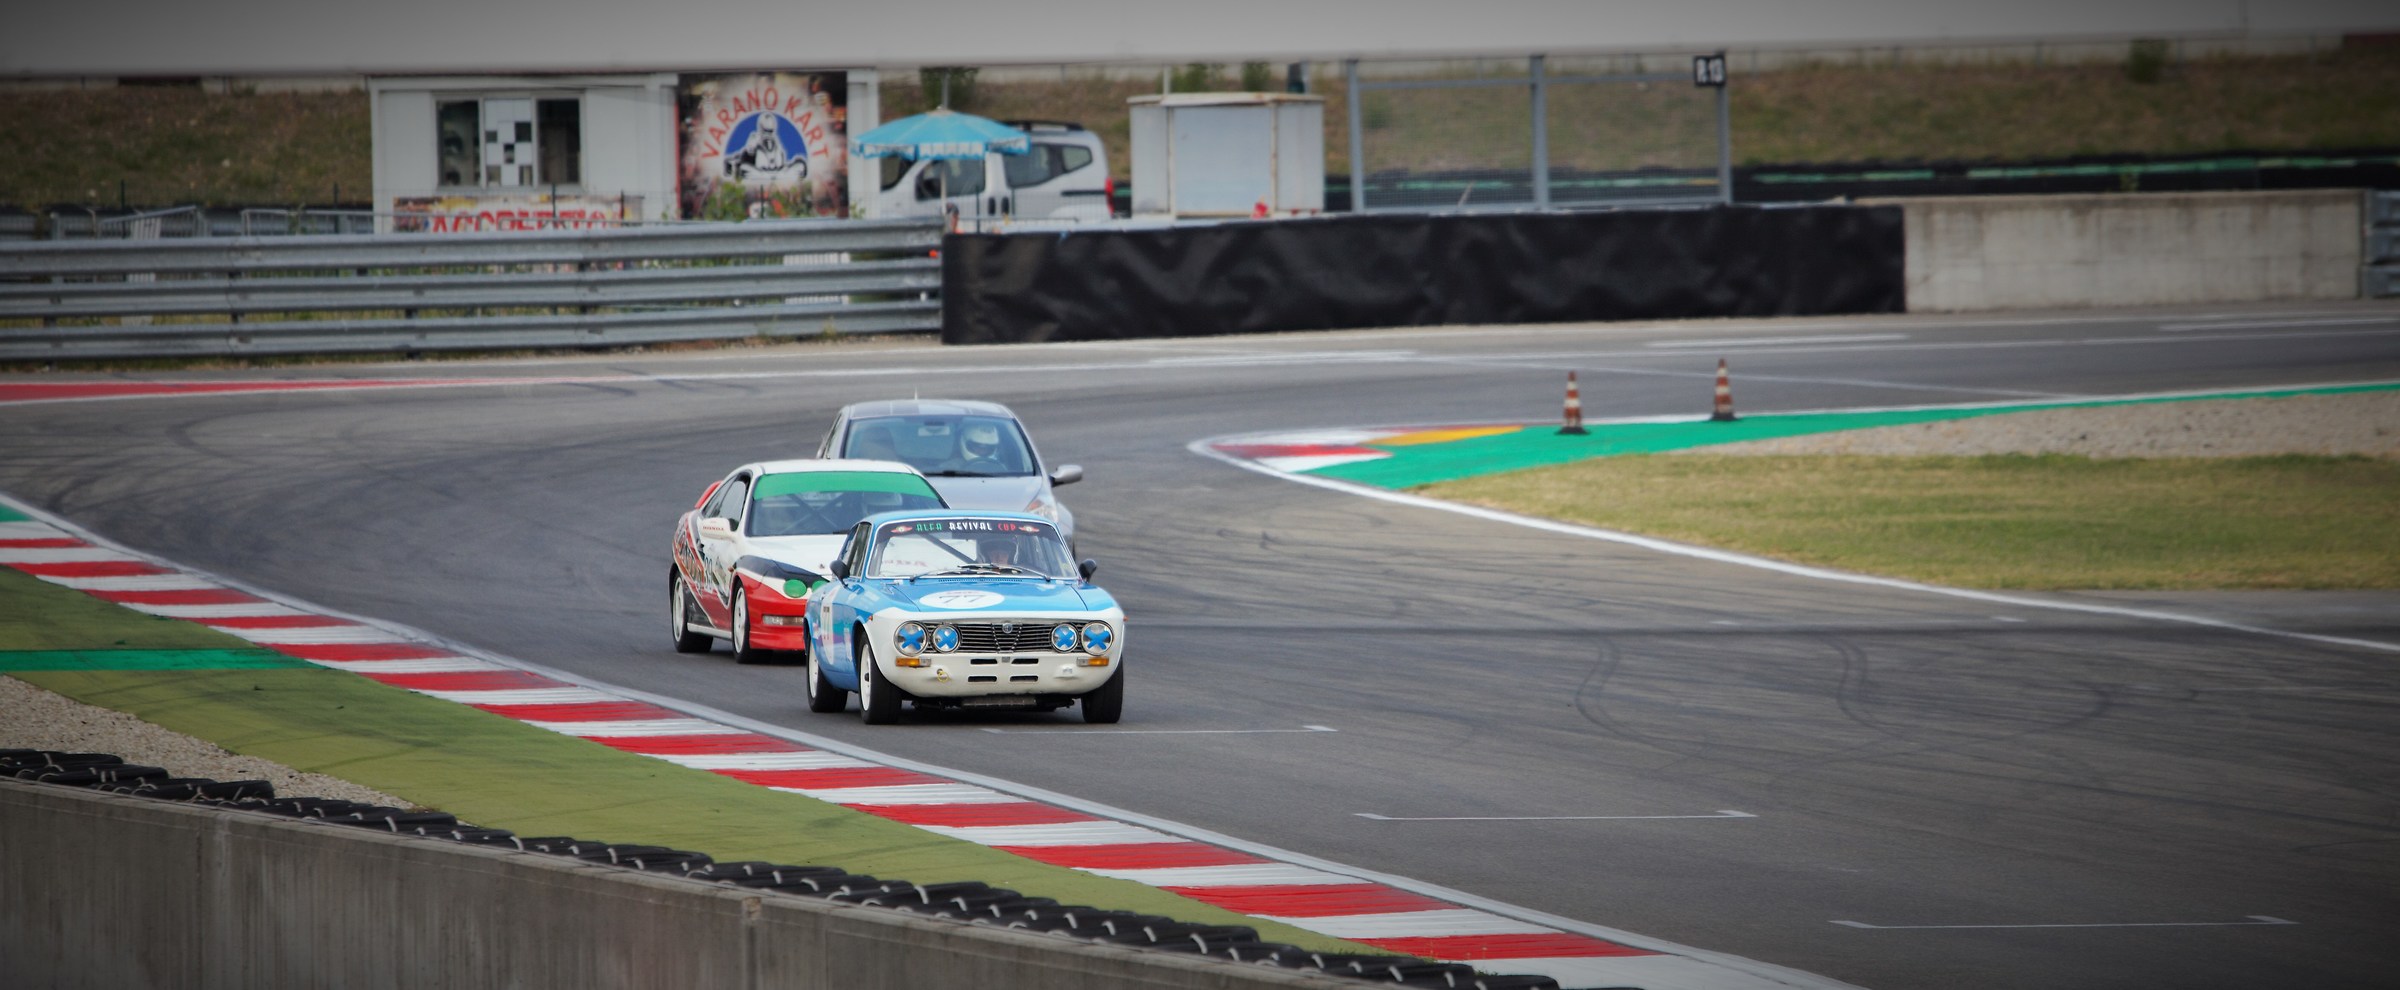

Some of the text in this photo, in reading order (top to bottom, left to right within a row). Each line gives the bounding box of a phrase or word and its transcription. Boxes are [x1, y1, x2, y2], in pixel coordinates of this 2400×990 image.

[702, 87, 829, 158] VARANO KART
[916, 521, 1016, 532] ALFA REVIVAL CUP
[938, 594, 987, 604] 77
